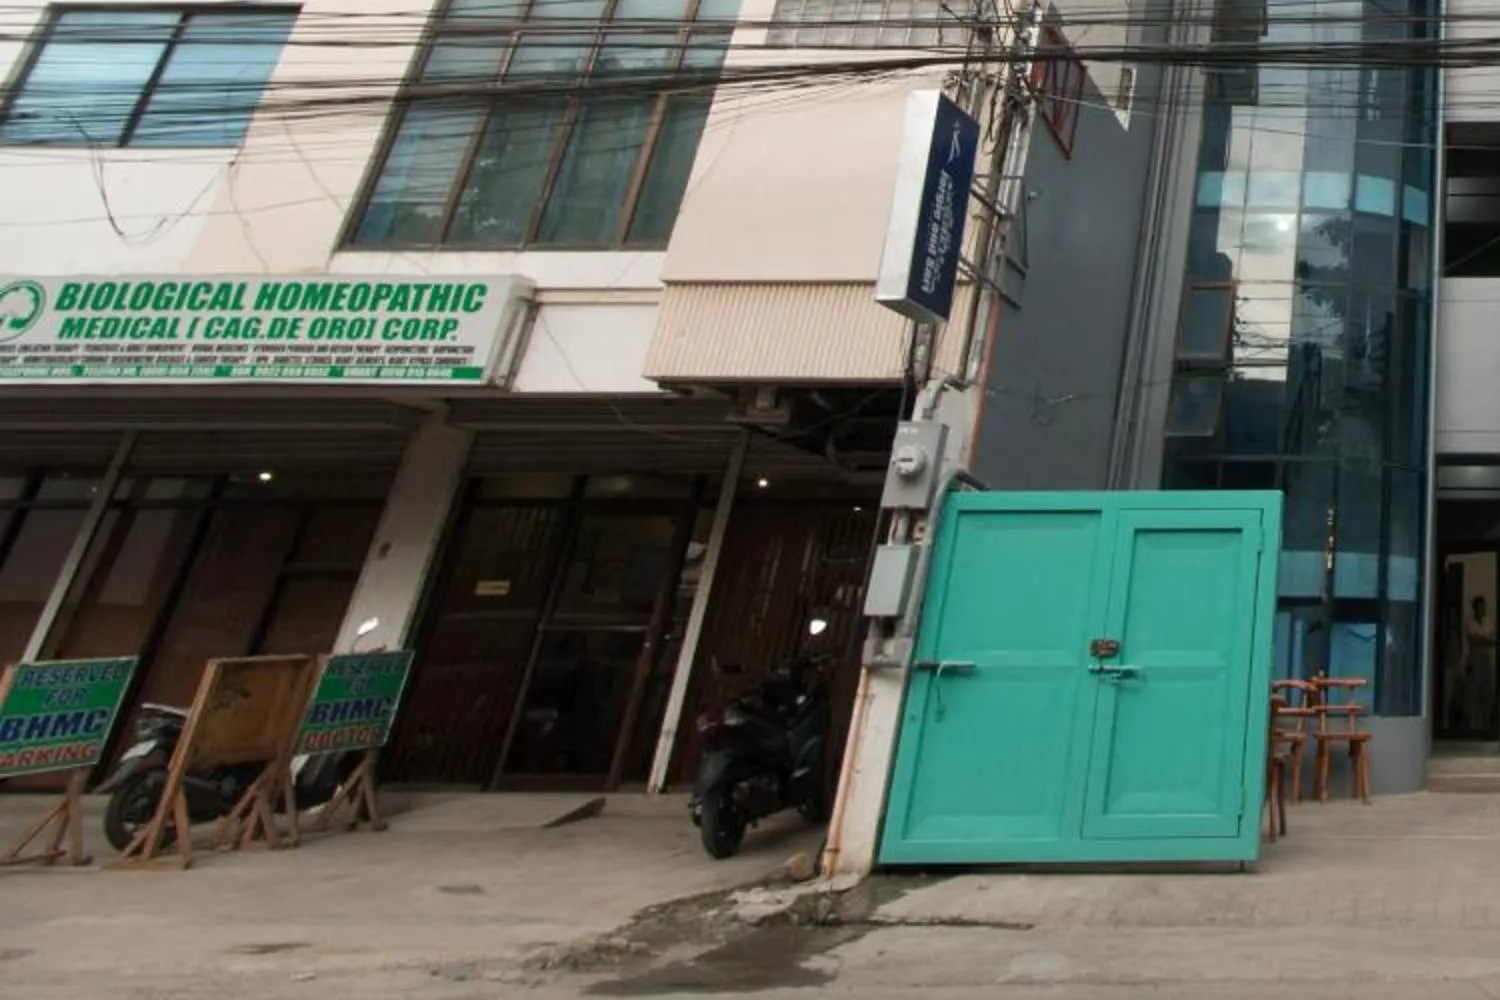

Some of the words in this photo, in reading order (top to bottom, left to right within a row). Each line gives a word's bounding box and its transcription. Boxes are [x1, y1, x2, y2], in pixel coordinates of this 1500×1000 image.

[54, 281, 248, 311] BIOLOGICAL
[253, 282, 488, 313] HOMEOPATHIC
[58, 317, 181, 339] MEDICAL
[381, 318, 459, 341] CORP.
[22, 662, 125, 686] RESERVED
[45, 686, 88, 707] FOR
[308, 698, 393, 725] BHMC
[0, 708, 108, 742] BHMC
[0, 742, 99, 768] ARKING
